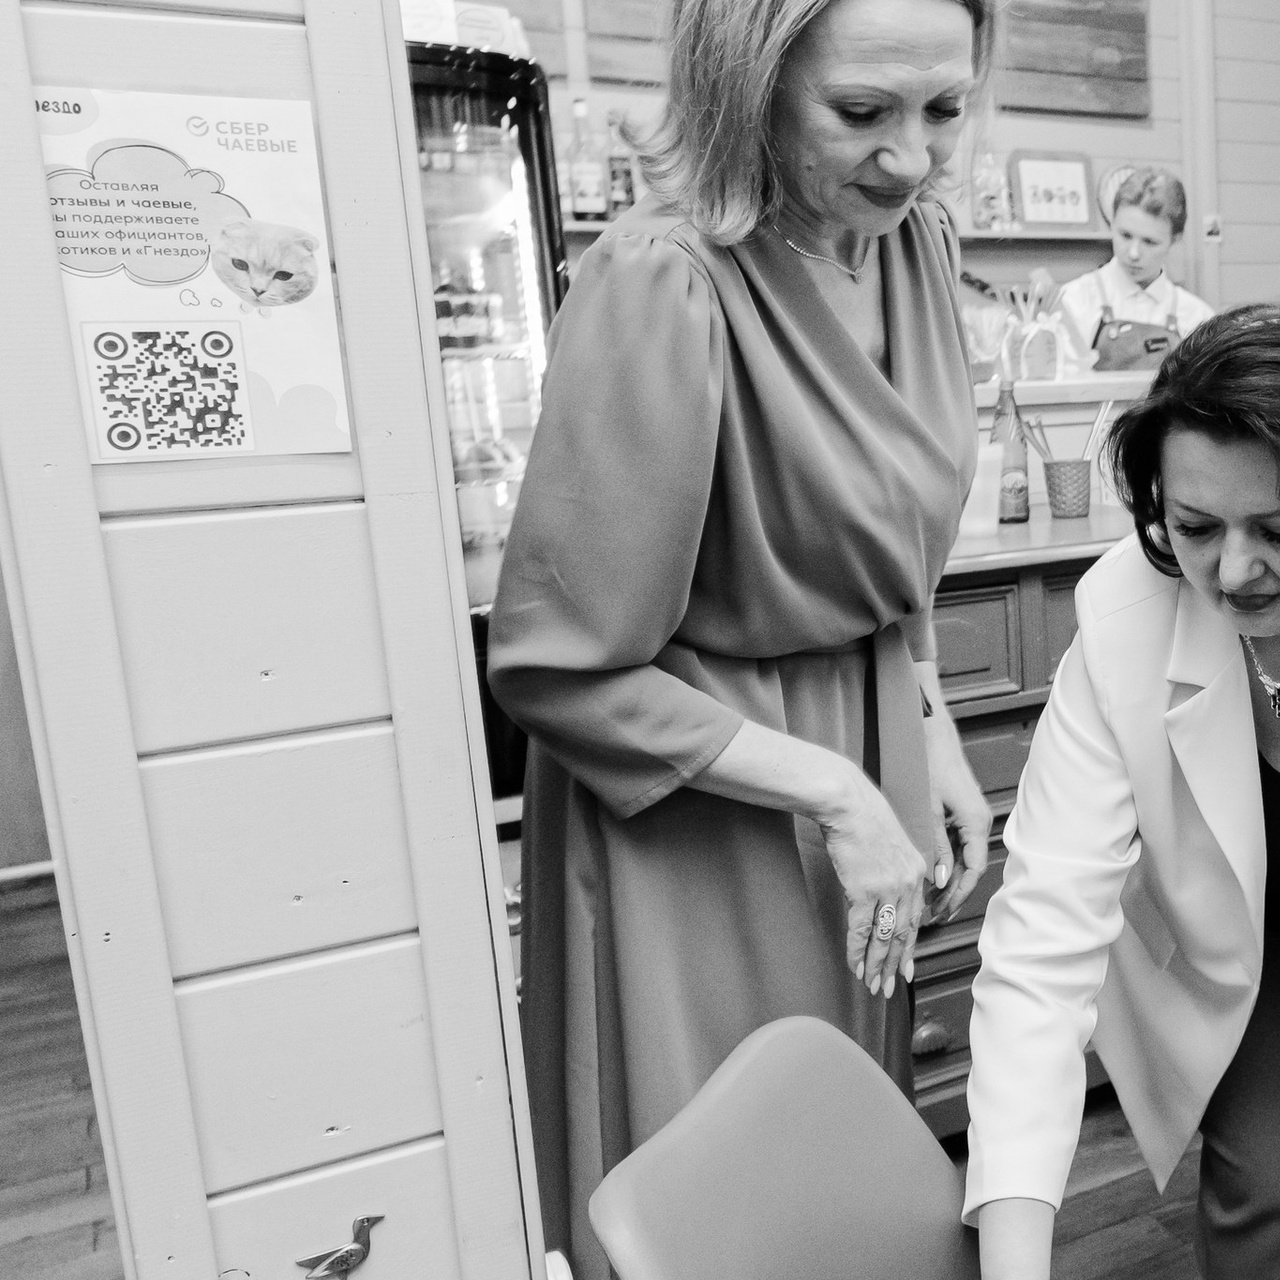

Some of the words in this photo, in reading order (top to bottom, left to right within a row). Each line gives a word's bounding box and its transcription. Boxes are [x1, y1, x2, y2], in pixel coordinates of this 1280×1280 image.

[215, 121, 269, 136] СБЕР
[217, 137, 298, 153] ЧАЕВЫЕ
[79, 179, 159, 192] Оставляя
[116, 199, 126, 207] и
[131, 199, 197, 211] чаевые,
[52, 214, 67, 222] ы
[71, 214, 200, 226] поддерживаете
[55, 230, 100, 239] аших
[104, 229, 208, 242] официантов,
[121, 247, 131, 256] и
[135, 245, 207, 258] «Гнездо»
